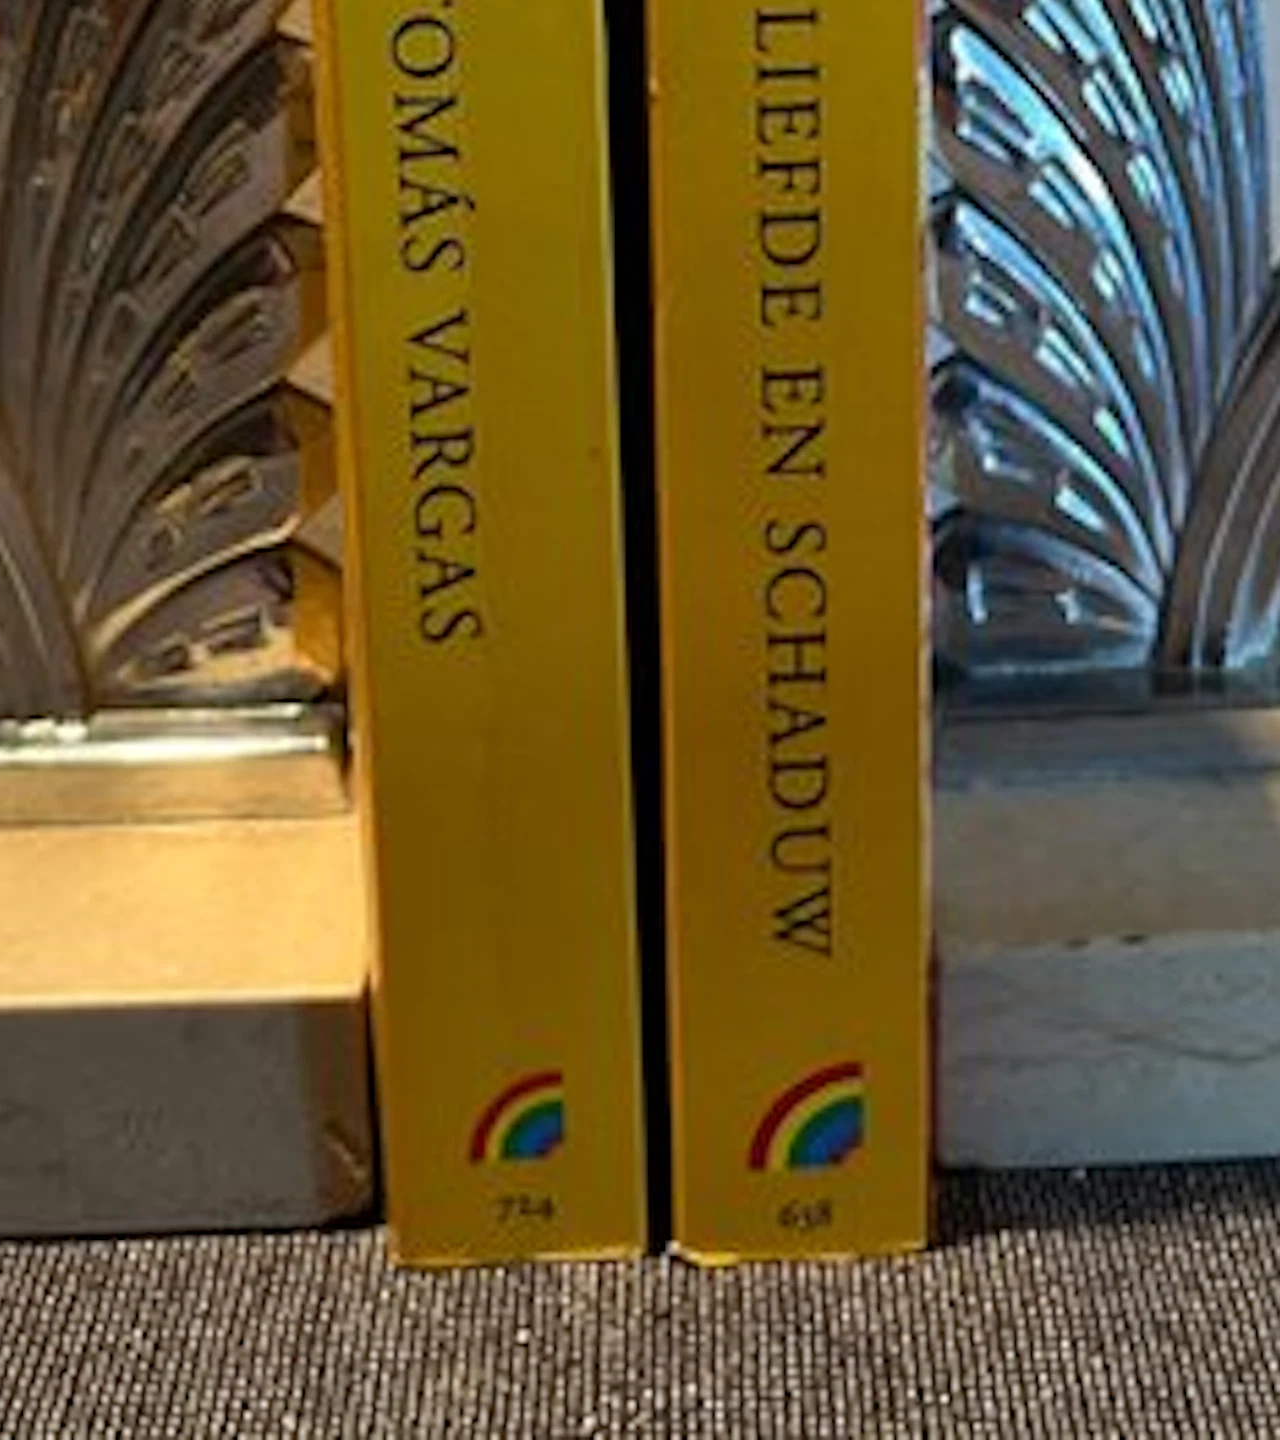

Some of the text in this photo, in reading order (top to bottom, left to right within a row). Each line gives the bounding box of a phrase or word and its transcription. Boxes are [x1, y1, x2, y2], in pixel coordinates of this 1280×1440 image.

[756, 9, 821, 327] LIEFDE
[403, 310, 482, 644] VARGAS
[761, 366, 827, 478] EN
[765, 521, 831, 958] SCHADUW
